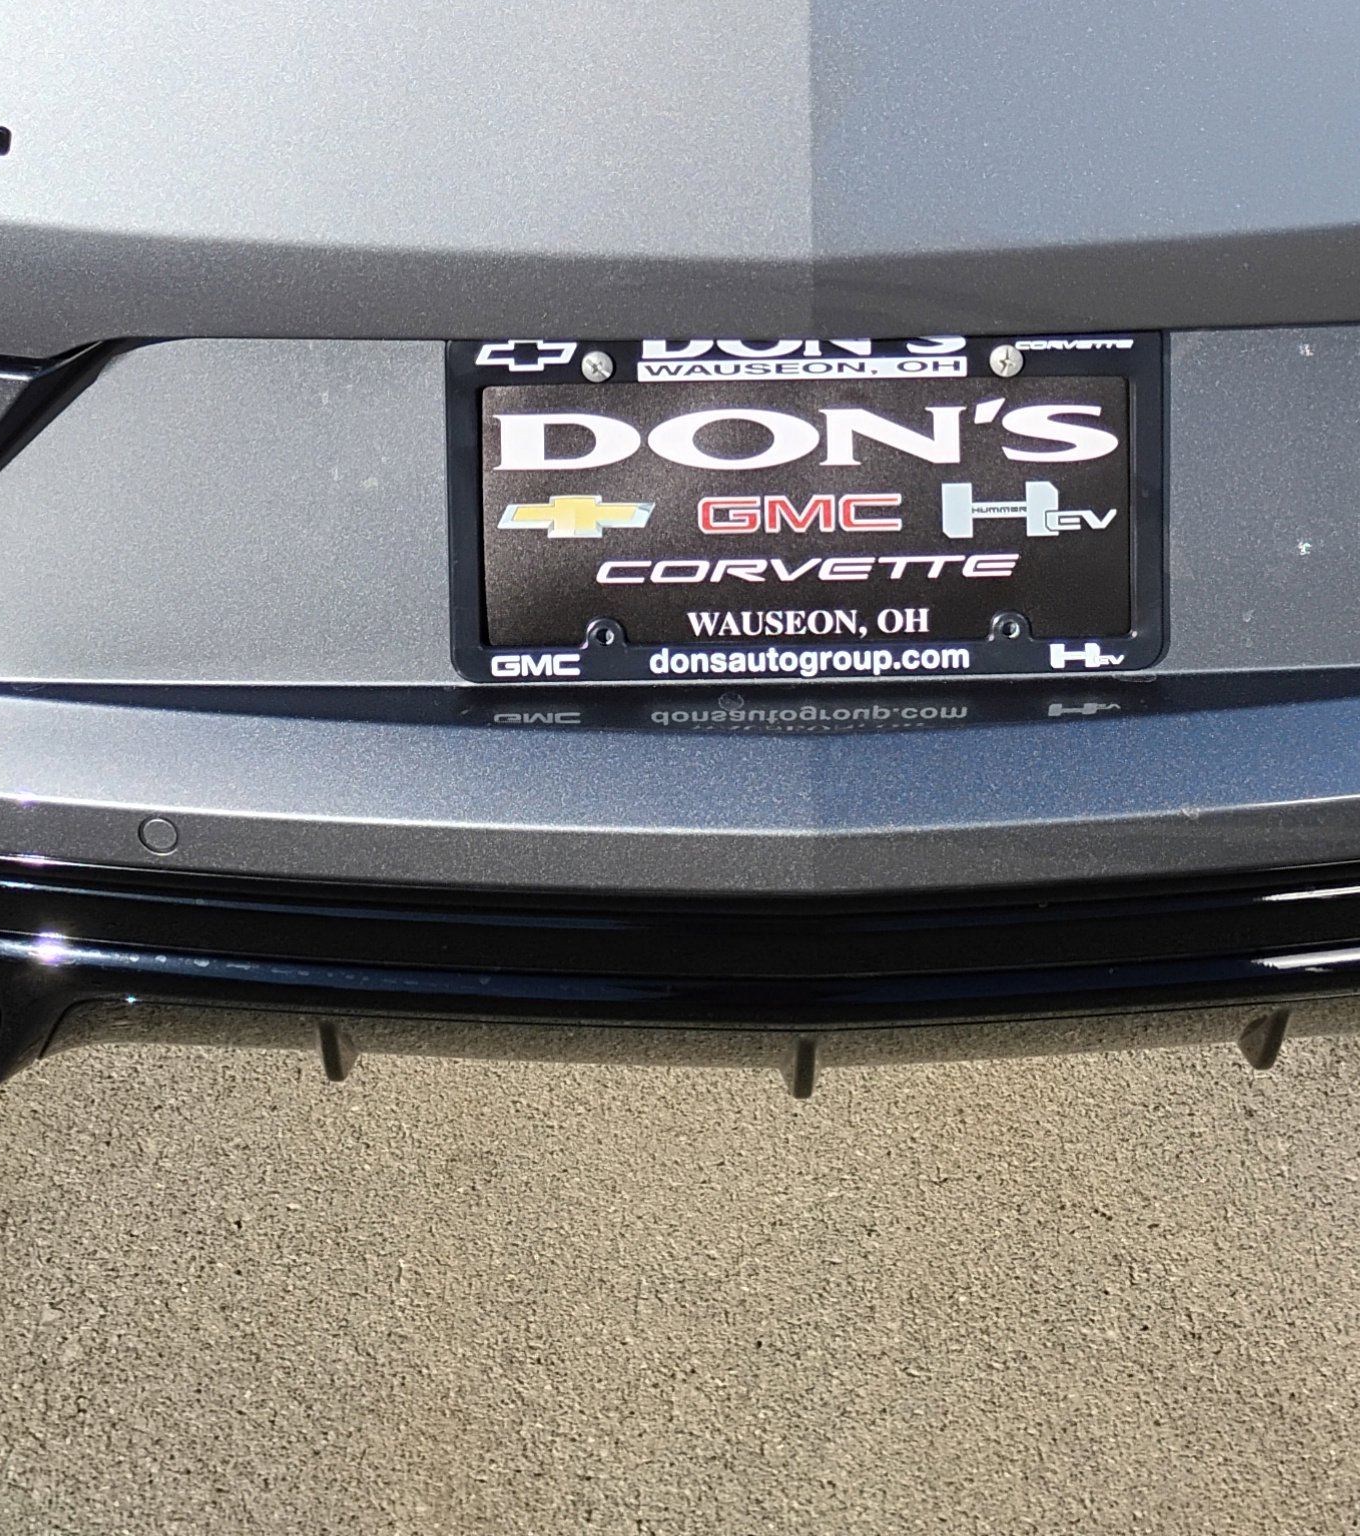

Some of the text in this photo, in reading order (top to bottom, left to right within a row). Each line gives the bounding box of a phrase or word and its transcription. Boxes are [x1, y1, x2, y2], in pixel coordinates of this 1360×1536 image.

[642, 335, 966, 360] DONS
[1015, 339, 1134, 350] CORVETTE
[644, 360, 960, 376] WAUSEON, OH
[492, 398, 1118, 470] DON'S
[697, 493, 902, 535] GMC
[972, 505, 1027, 514] HUMMER
[596, 553, 1019, 584] CORVETTE
[687, 608, 930, 639] WAUSEON, OH
[491, 654, 581, 677] GMC
[649, 647, 970, 677] donsautogroup.com
